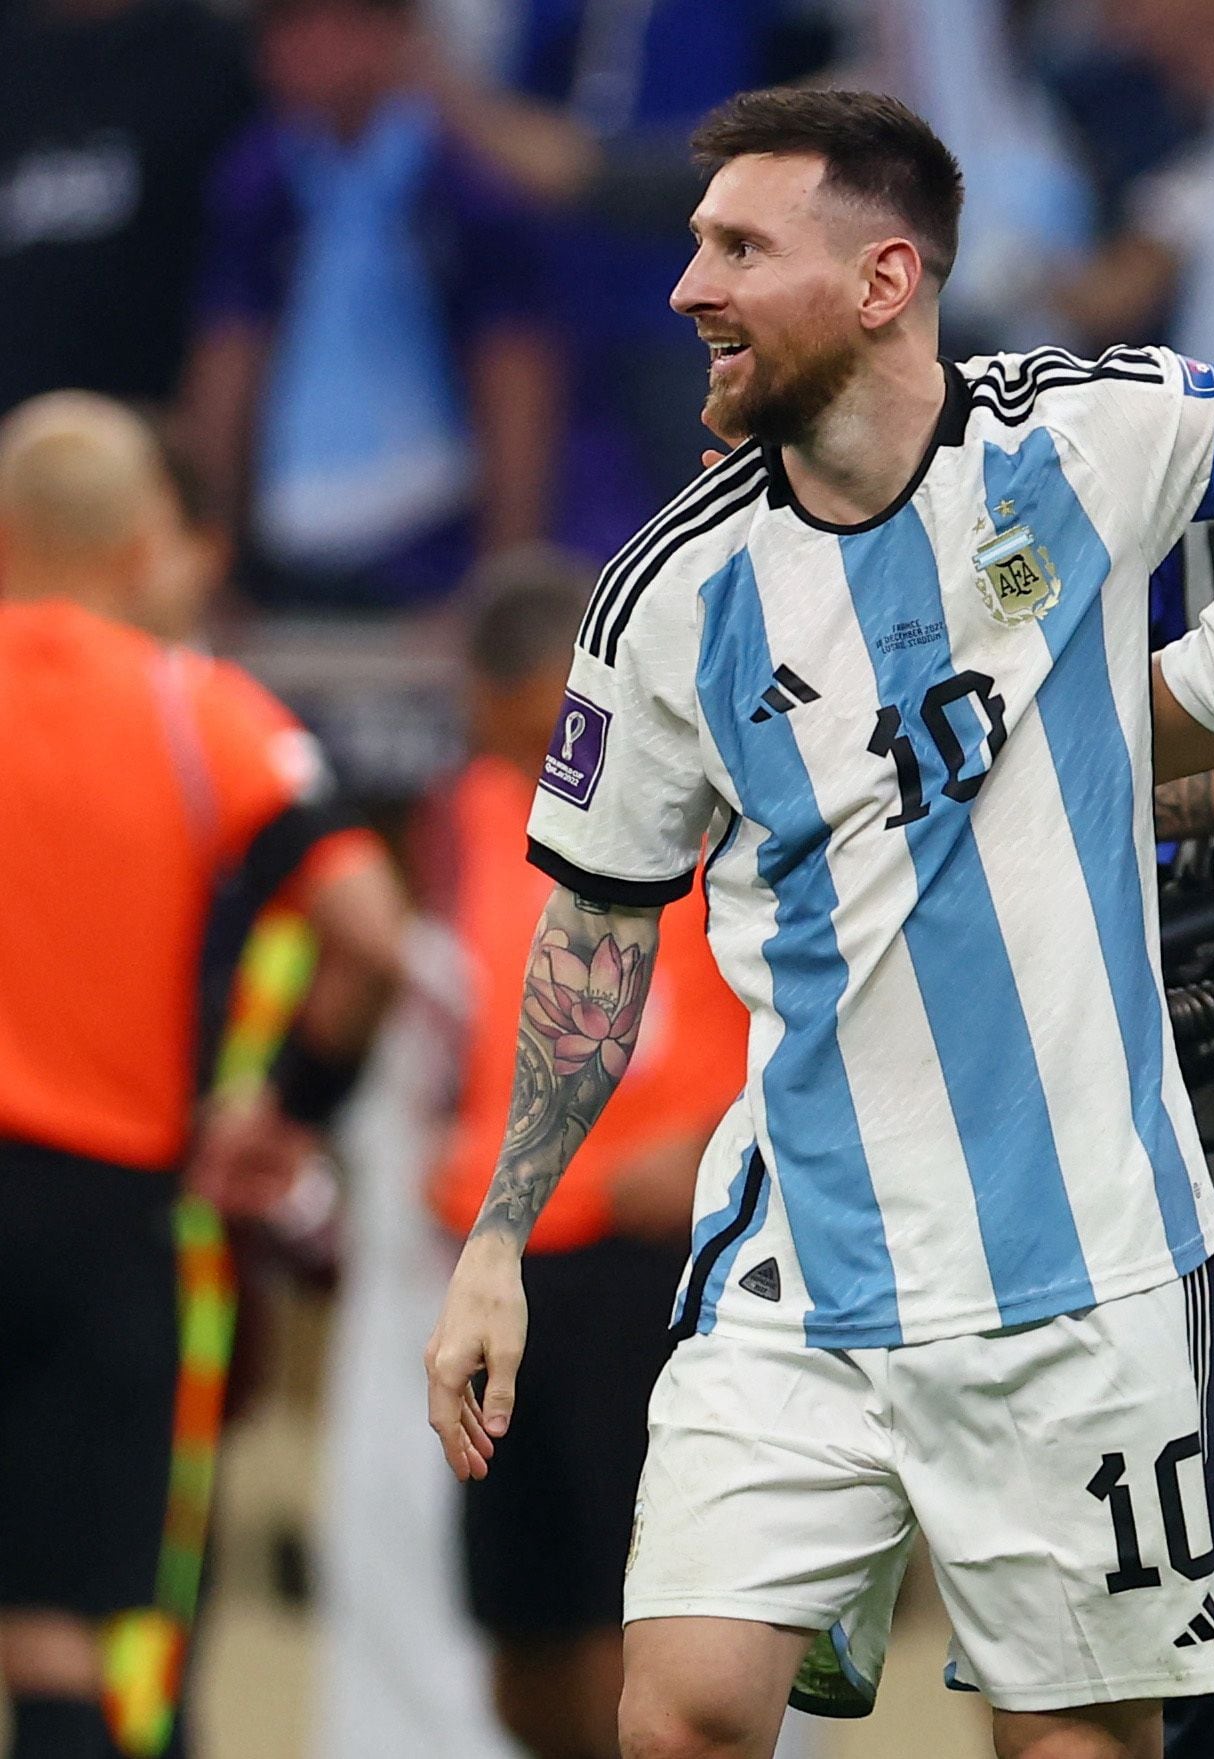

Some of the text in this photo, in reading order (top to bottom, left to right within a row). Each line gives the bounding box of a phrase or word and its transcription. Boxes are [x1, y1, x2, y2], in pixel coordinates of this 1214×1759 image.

[995, 553, 1040, 599] AFA
[884, 627, 923, 644] DECEMBER
[924, 621, 944, 634] 2022
[907, 632, 942, 648] STADIUM
[866, 669, 1008, 831] 10
